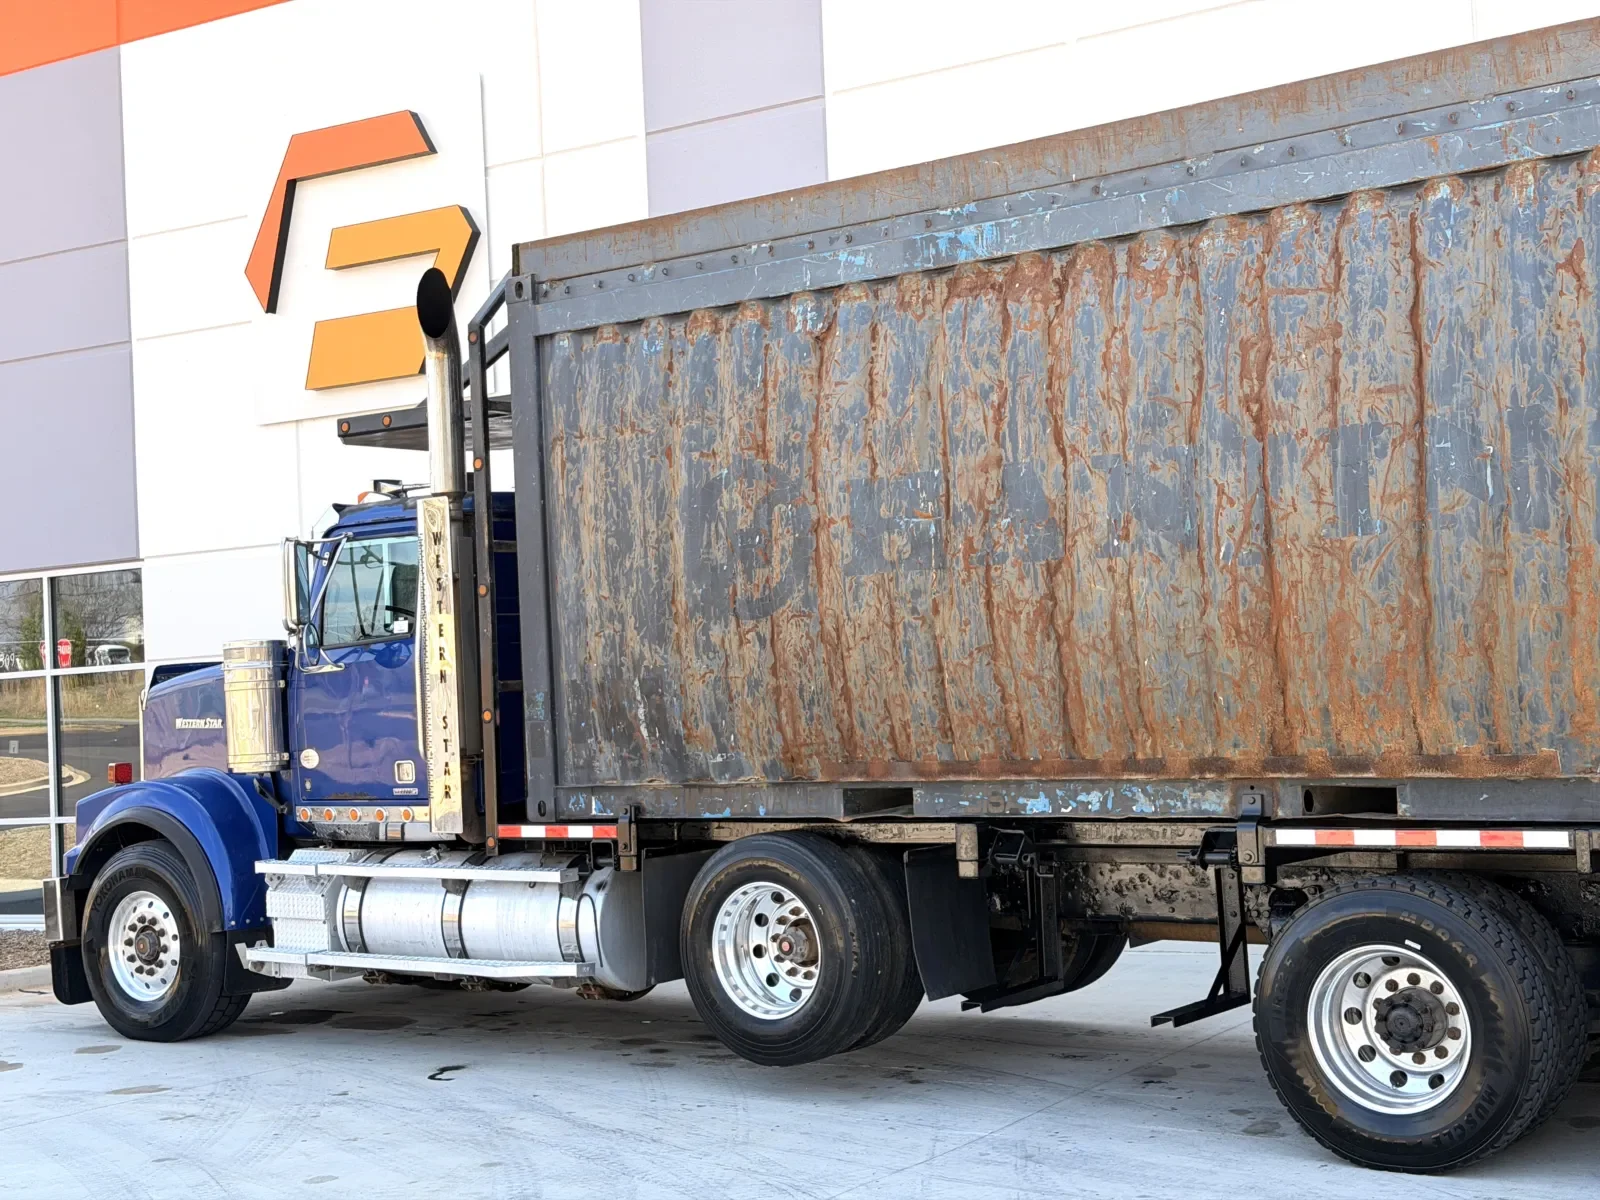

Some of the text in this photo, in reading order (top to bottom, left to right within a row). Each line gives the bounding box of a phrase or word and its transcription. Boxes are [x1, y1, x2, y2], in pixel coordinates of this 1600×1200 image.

[432, 531, 452, 800] WESTERN STAR
[175, 717, 224, 729] WESTERN STAR
[91, 867, 143, 913] YOKOHAMA
[1431, 1084, 1500, 1147] MUSCLE
